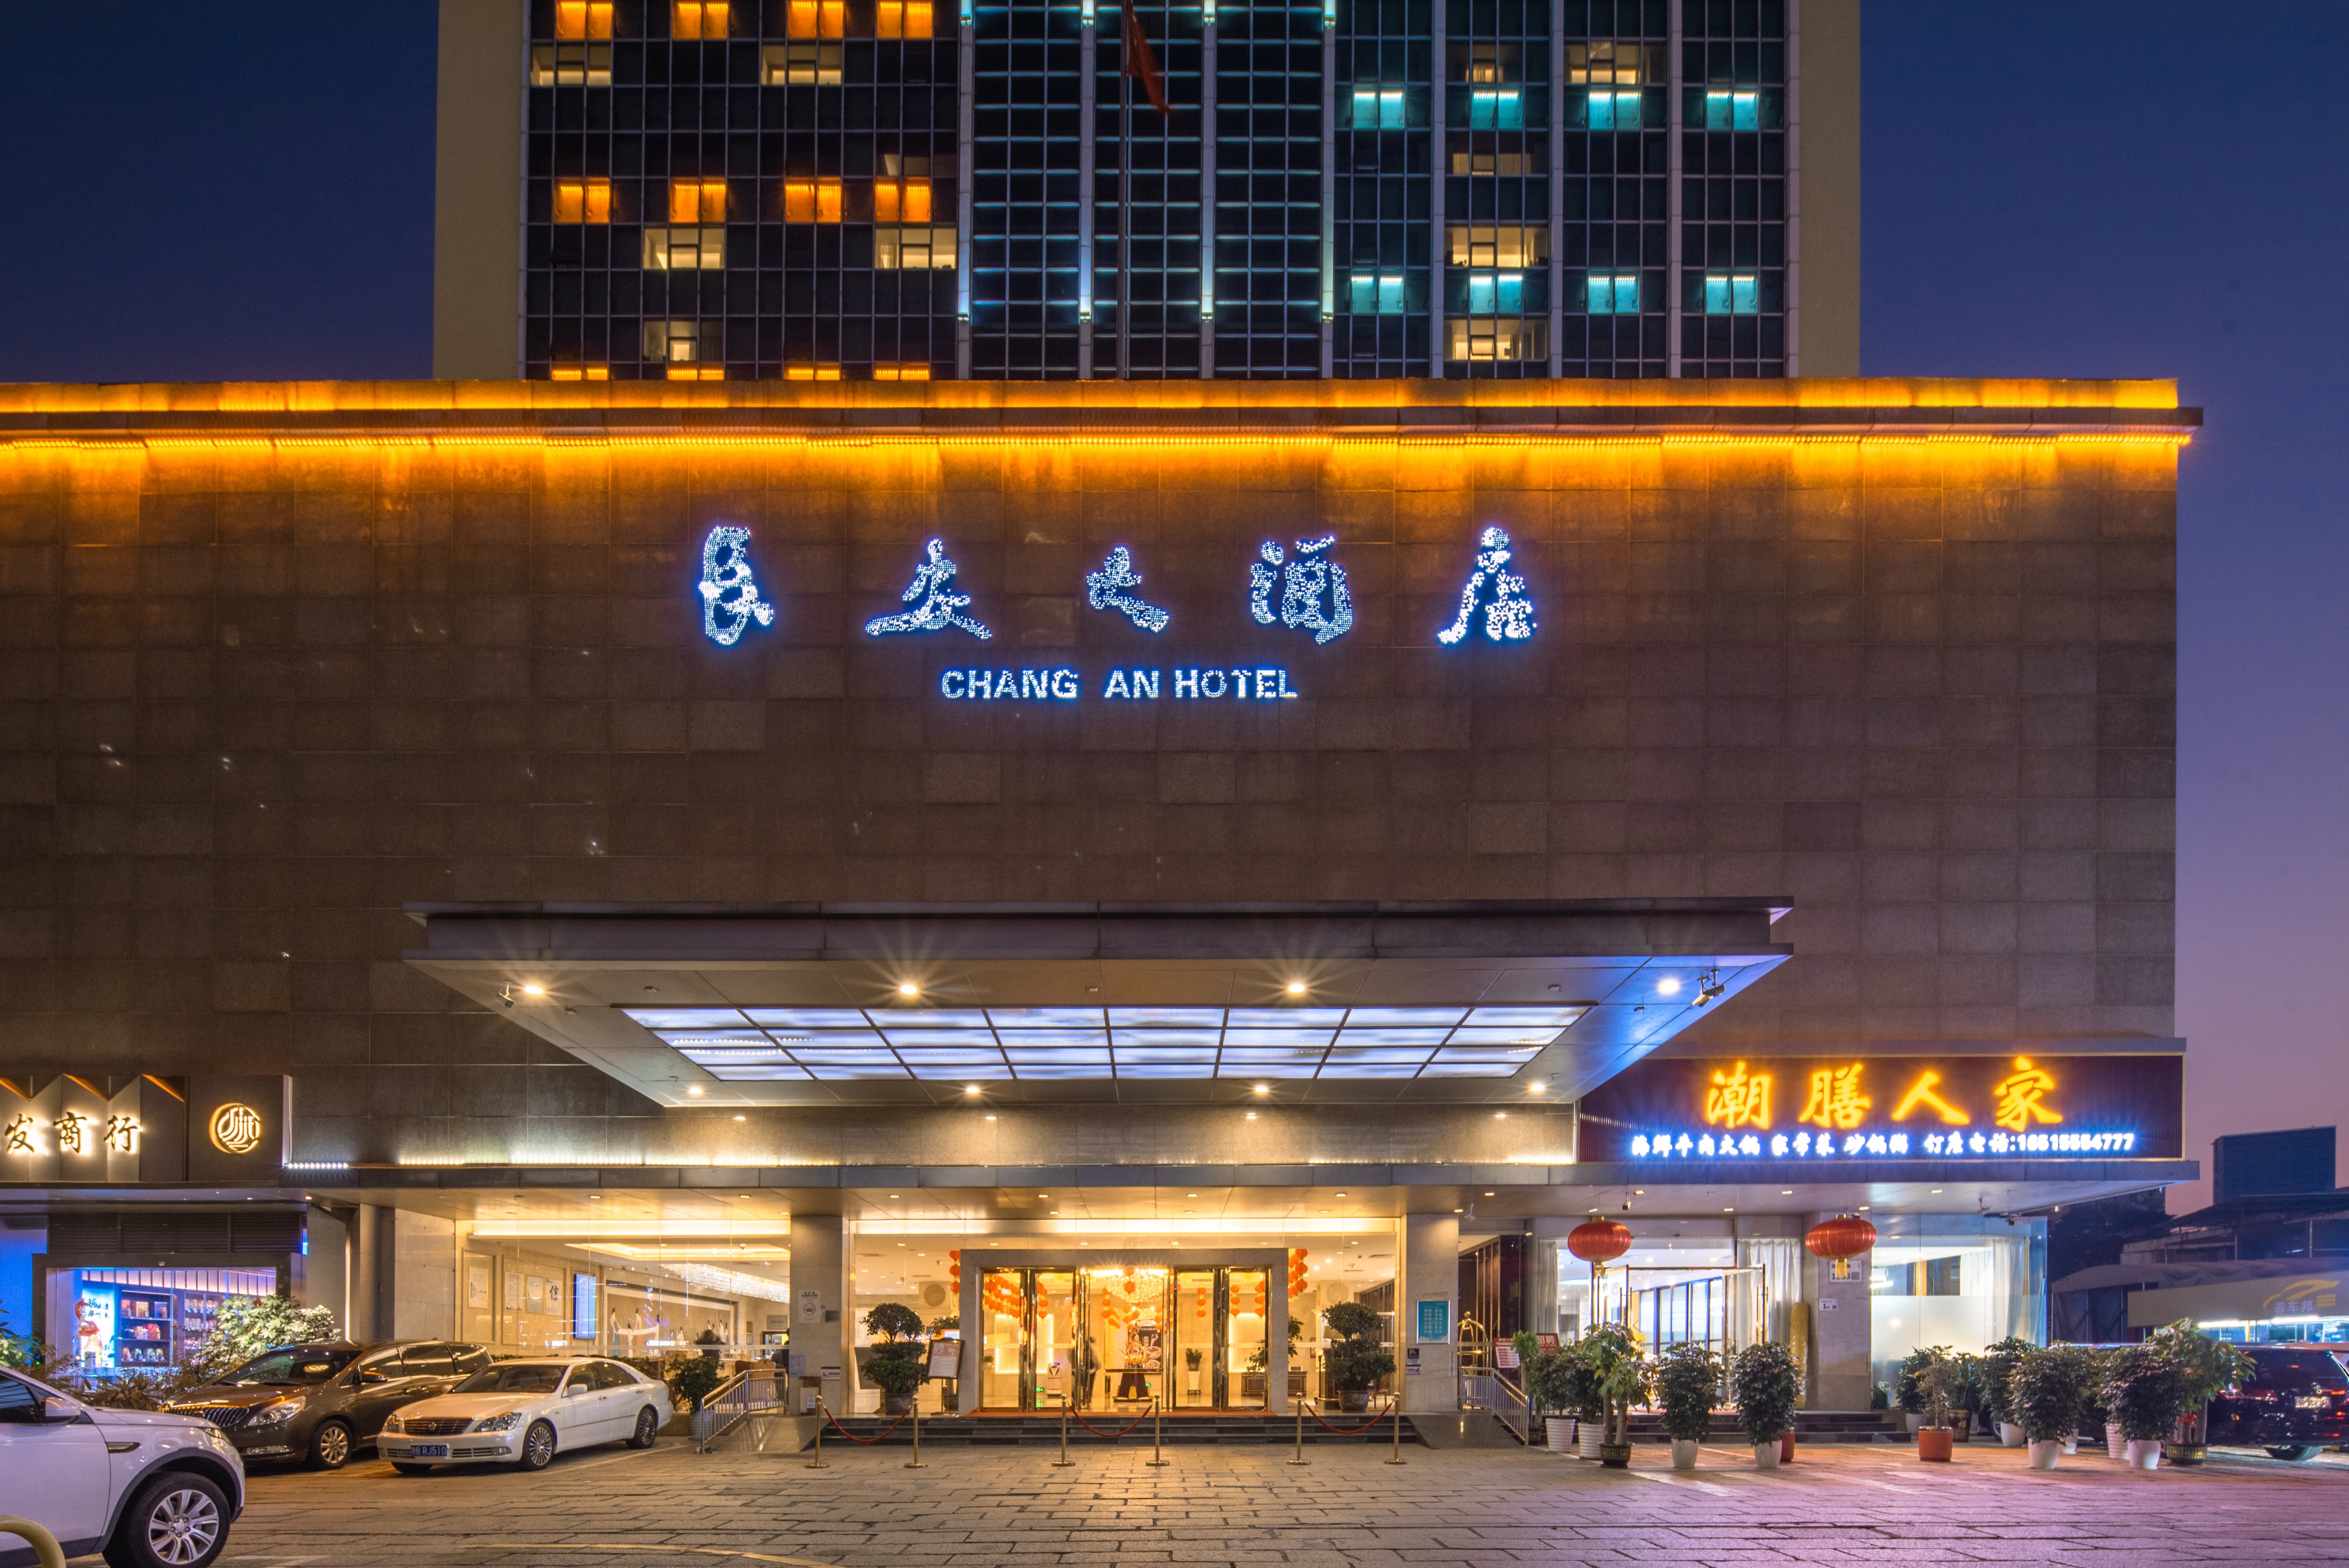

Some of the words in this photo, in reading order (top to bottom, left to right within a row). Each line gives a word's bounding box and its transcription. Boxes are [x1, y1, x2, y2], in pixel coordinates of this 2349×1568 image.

[942, 670, 1078, 700] CHANG
[1105, 670, 1160, 699] AN
[1175, 670, 1298, 699] HOTEL
[1705, 1055, 2064, 1131] 潮膳人家
[5, 1112, 141, 1153] 发商行
[2274, 1300, 2313, 1314] 养车邦
